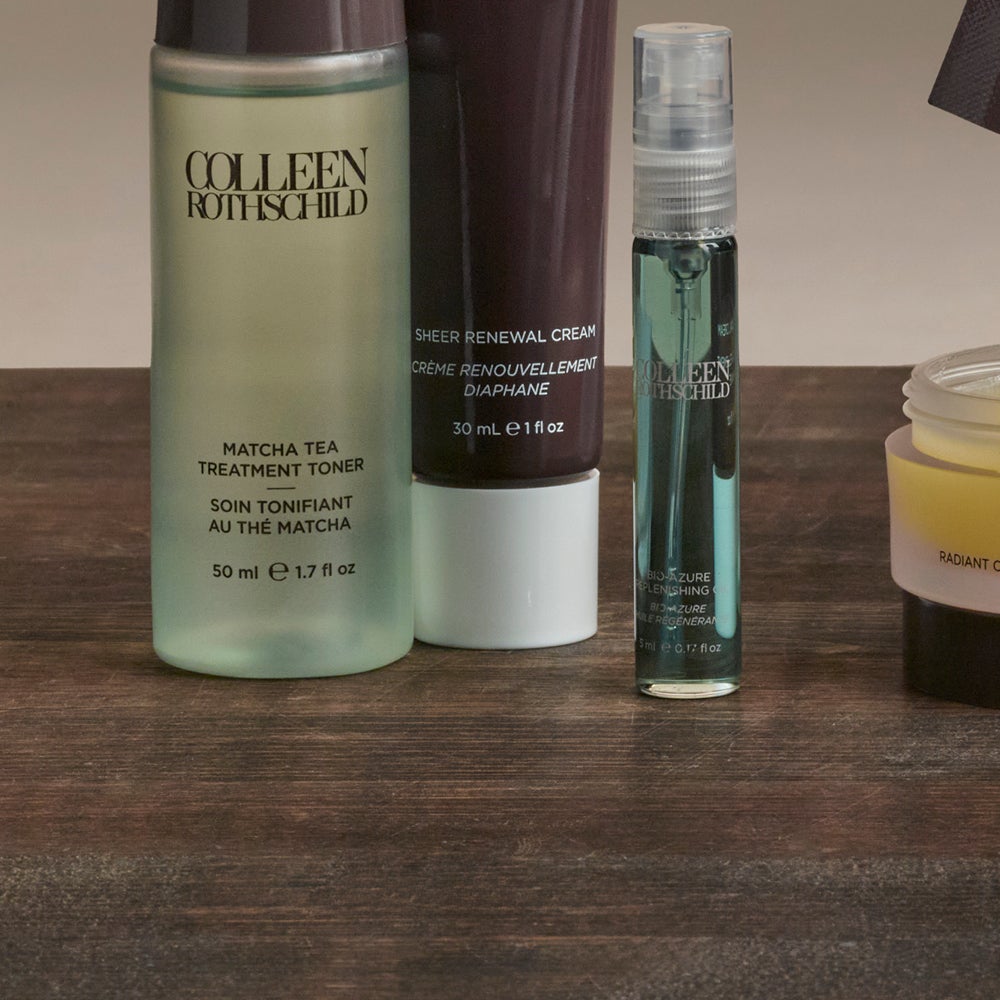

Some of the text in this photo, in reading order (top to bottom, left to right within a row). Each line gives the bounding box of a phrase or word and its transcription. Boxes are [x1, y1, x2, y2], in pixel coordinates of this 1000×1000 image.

[185, 147, 368, 191] COLLEEN
[187, 188, 368, 221] ROTHSCHILD
[415, 324, 596, 344] SHEER RENEWAL CREAM
[412, 356, 598, 377] CRÈME RENOUVELLEMENT
[637, 359, 730, 384] OLLEEN
[463, 382, 550, 397] DIAPHANE
[453, 422, 472, 435] 30
[477, 422, 501, 436] mL
[524, 421, 530, 434] 1
[534, 421, 543, 434] fl
[547, 422, 564, 434] oz
[223, 440, 338, 457] MATCHA TEA
[198, 457, 364, 477] TREATMENT TONER
[210, 495, 353, 514] SOIN TONIFIANT
[209, 517, 351, 535] AU THÉ MATCHA
[939, 550, 989, 570] RADIANT
[213, 564, 233, 578] 50
[239, 565, 258, 579] ml
[295, 565, 316, 579] 1.7
[322, 563, 332, 577] fl
[338, 563, 356, 576] oz
[700, 643, 707, 653] fl
[709, 644, 721, 652] oz
